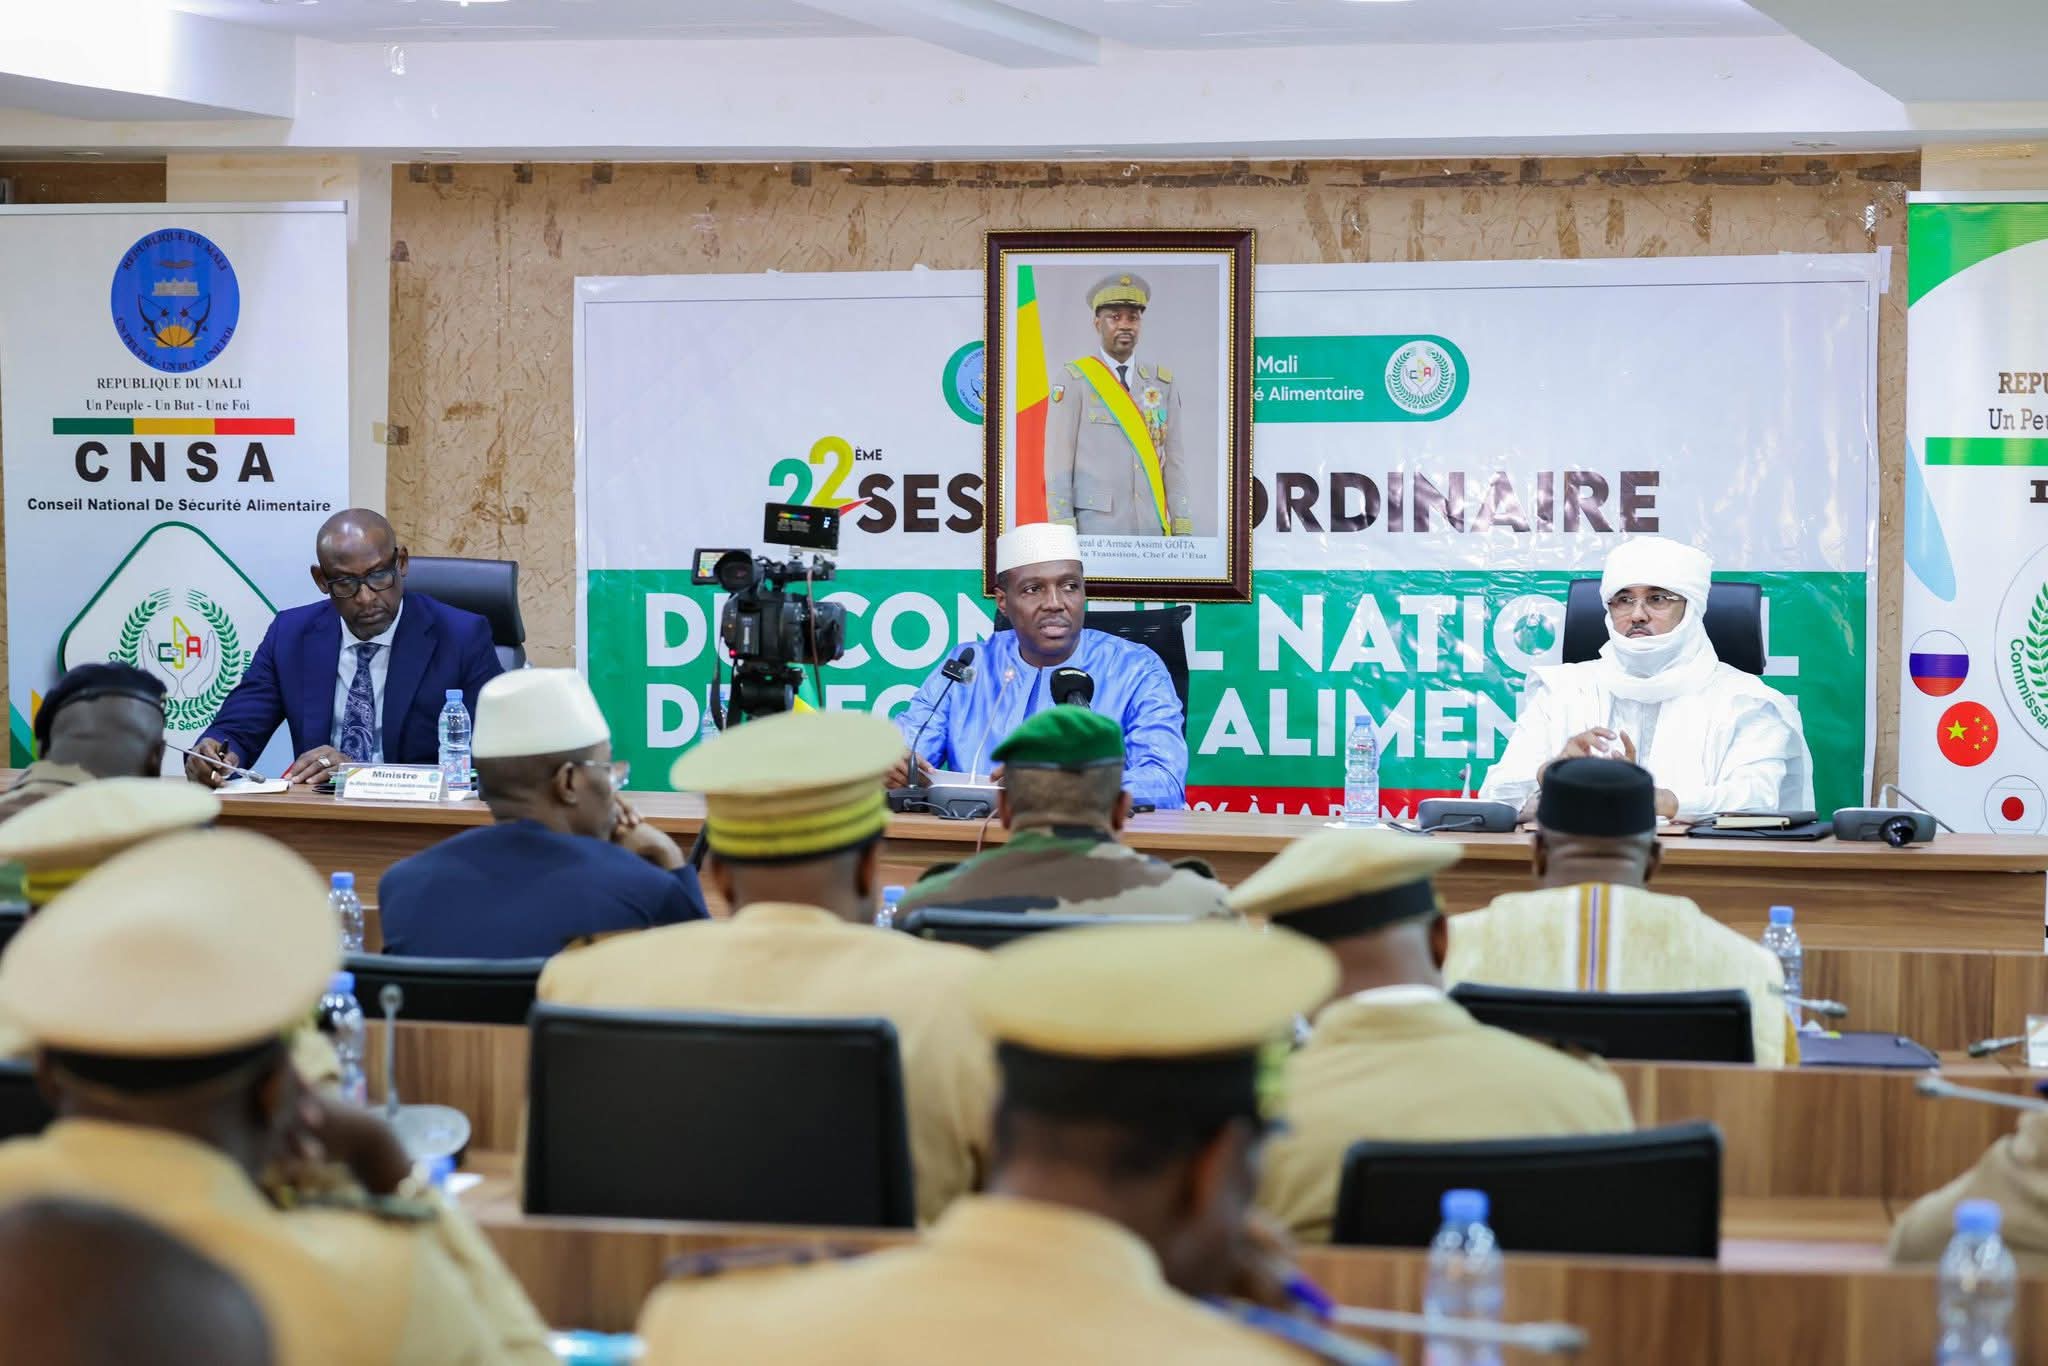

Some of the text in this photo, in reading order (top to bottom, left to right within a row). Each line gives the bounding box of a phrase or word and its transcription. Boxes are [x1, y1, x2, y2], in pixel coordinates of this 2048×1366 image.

[1256, 354, 1298, 374] Mali
[97, 377, 242, 391] REPUBLIQUE DU MALI
[1998, 372, 2048, 394] REP
[1268, 385, 1365, 401] Alimentaire
[86, 399, 101, 411] Un
[106, 399, 143, 413] Peuple
[155, 399, 170, 411] Un
[174, 399, 194, 411] But
[206, 399, 229, 411] Une
[233, 399, 250, 411] Foi
[1988, 407, 2048, 430] Un Pe
[27, 498, 331, 512] Conseil National De Sécurité Alimentaire
[857, 470, 1660, 533] SES RDINAIRE
[1143, 551, 1165, 559] Chef
[1168, 551, 1178, 559] de
[1258, 593, 1799, 676] NATIOL
[1197, 687, 1526, 759] ALIMEN
[372, 770, 418, 780] Ministre
